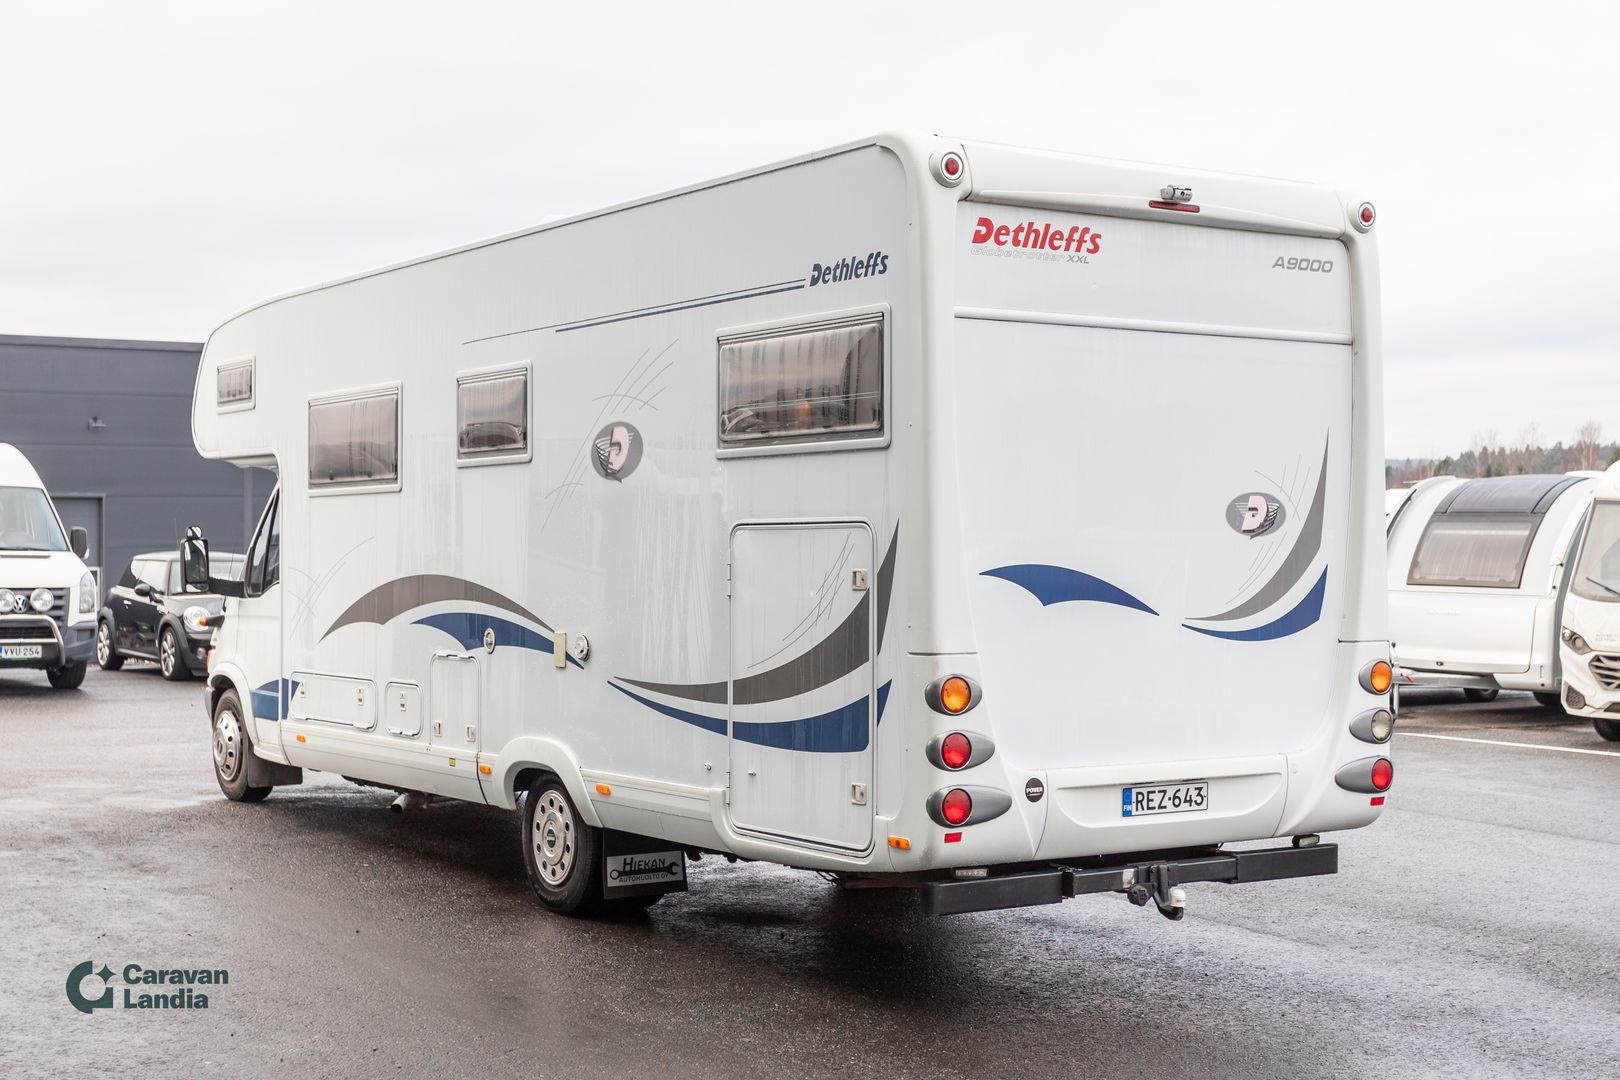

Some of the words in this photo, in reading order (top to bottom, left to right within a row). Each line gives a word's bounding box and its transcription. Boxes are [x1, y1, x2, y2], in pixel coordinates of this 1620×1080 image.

[971, 216, 1102, 254] Dethleffs
[809, 250, 888, 287] Dethleffs
[1066, 253, 1090, 264] XXL
[1271, 256, 1334, 273] A9000
[1135, 786, 1204, 812] REZ-643
[622, 856, 666, 872] HIEKAN
